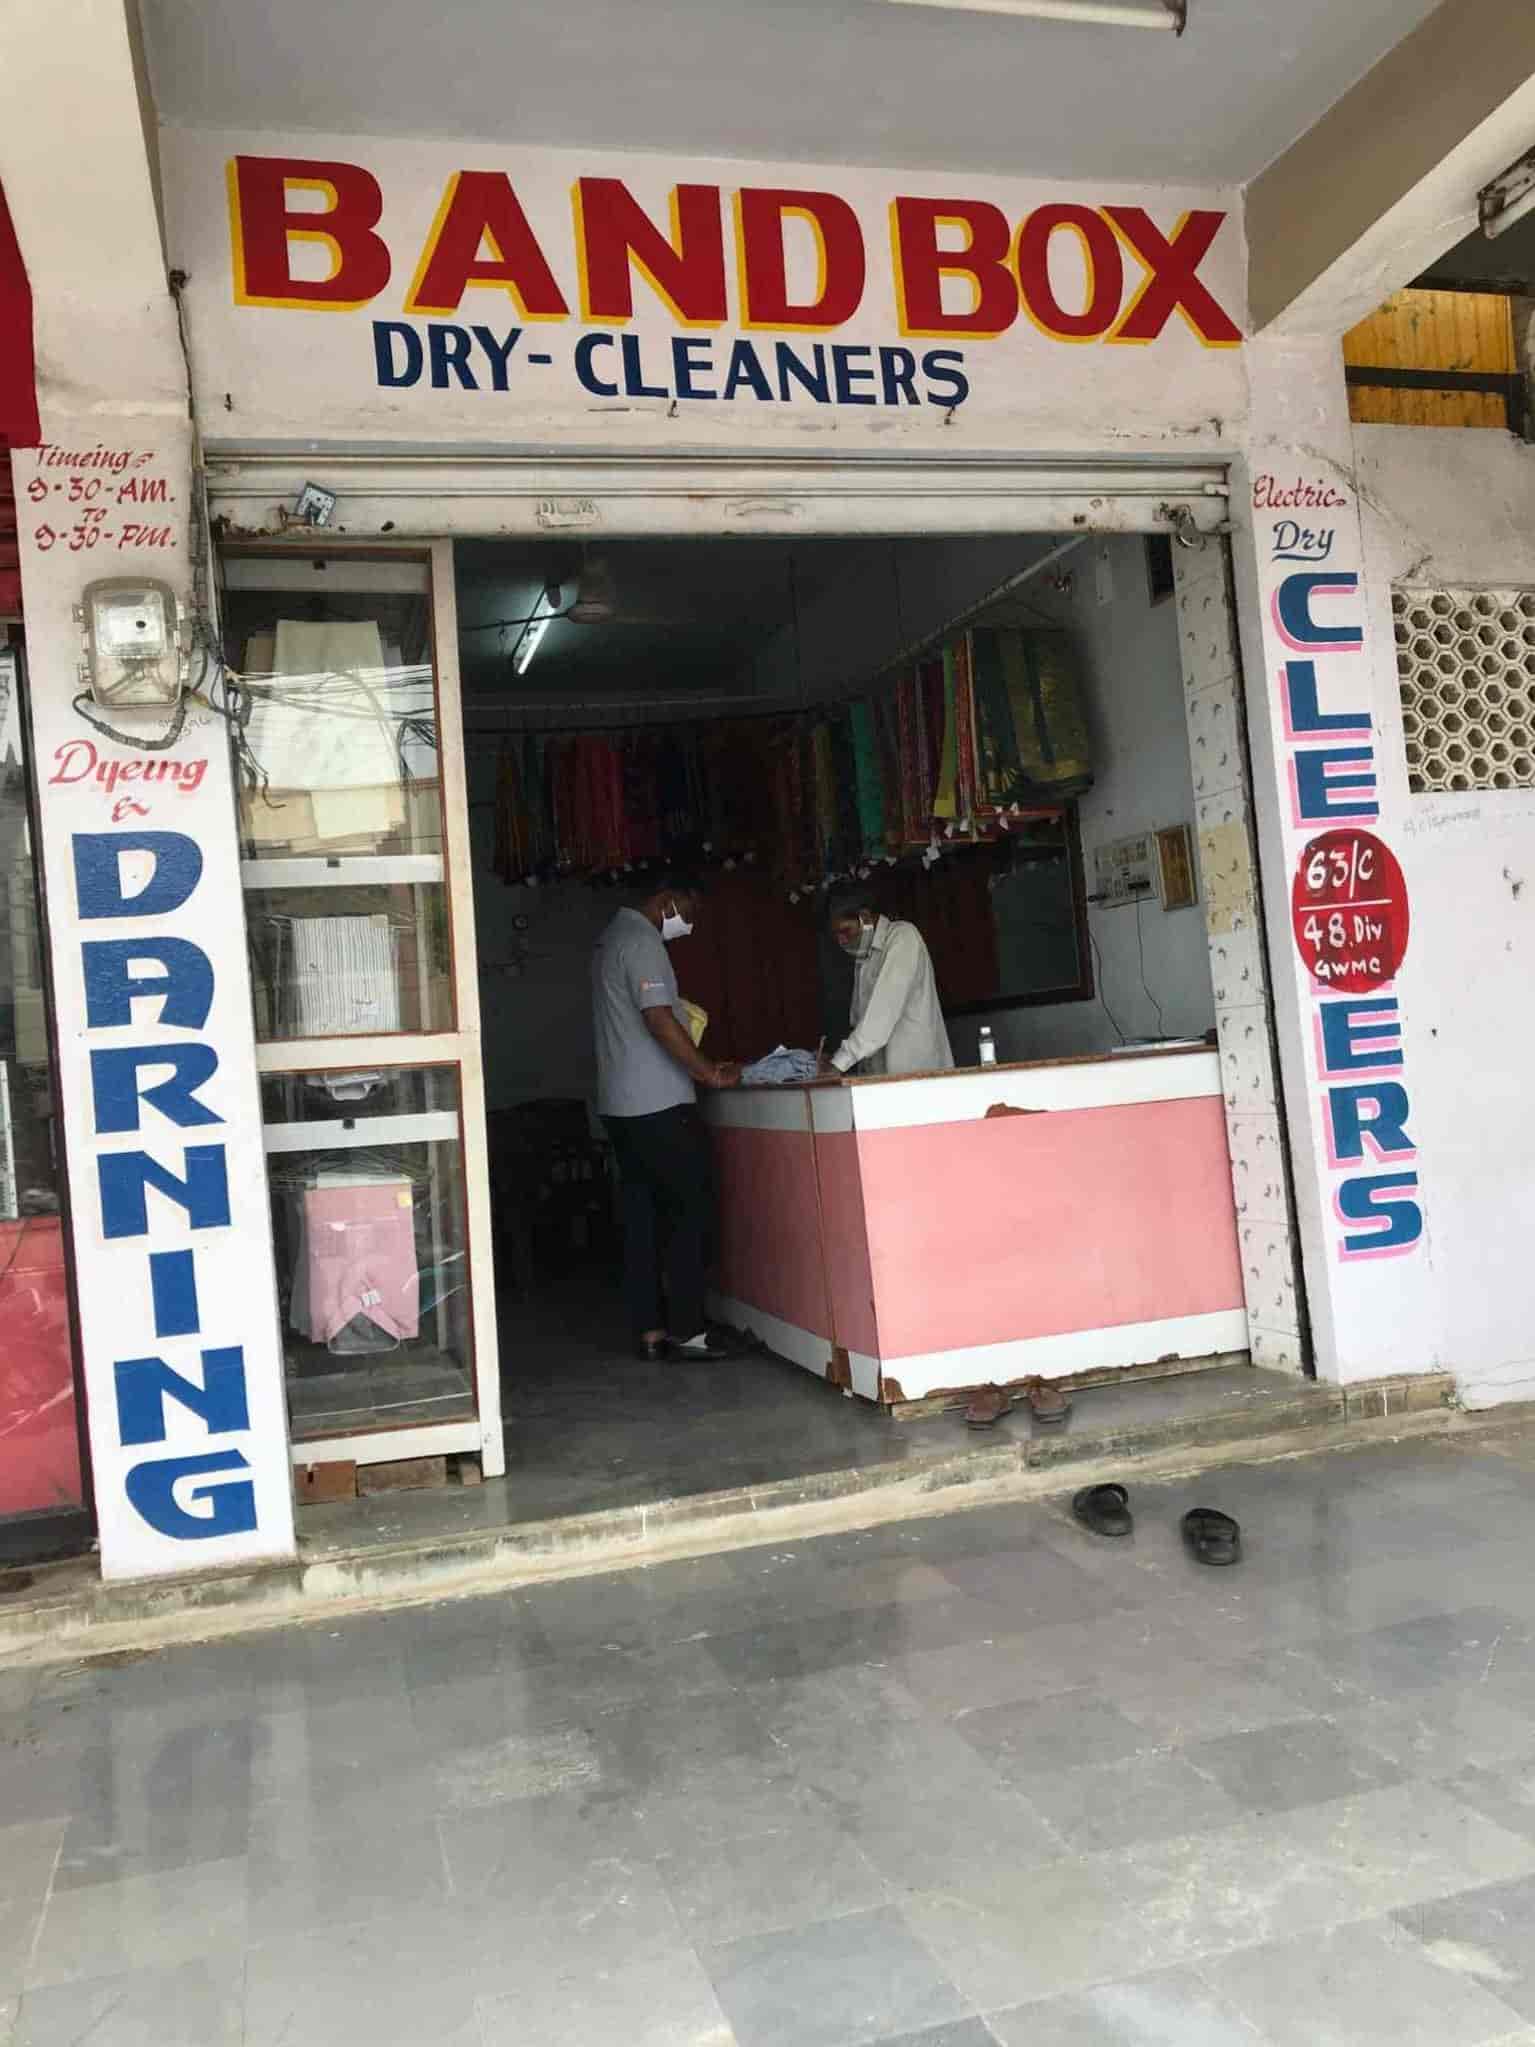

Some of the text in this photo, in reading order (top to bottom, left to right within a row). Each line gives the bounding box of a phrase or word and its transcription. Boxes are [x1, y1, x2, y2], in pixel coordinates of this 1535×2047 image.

[226, 154, 1243, 347] BAND BOX
[573, 331, 970, 407] CLEANERS
[1271, 520, 1335, 561] Dry
[48, 739, 209, 792] Dyeing
[1306, 839, 1374, 899] 63/C
[1271, 572, 1424, 1263] CLEERS
[1314, 957, 1381, 978] GWMC
[71, 830, 257, 1542] DARNING
